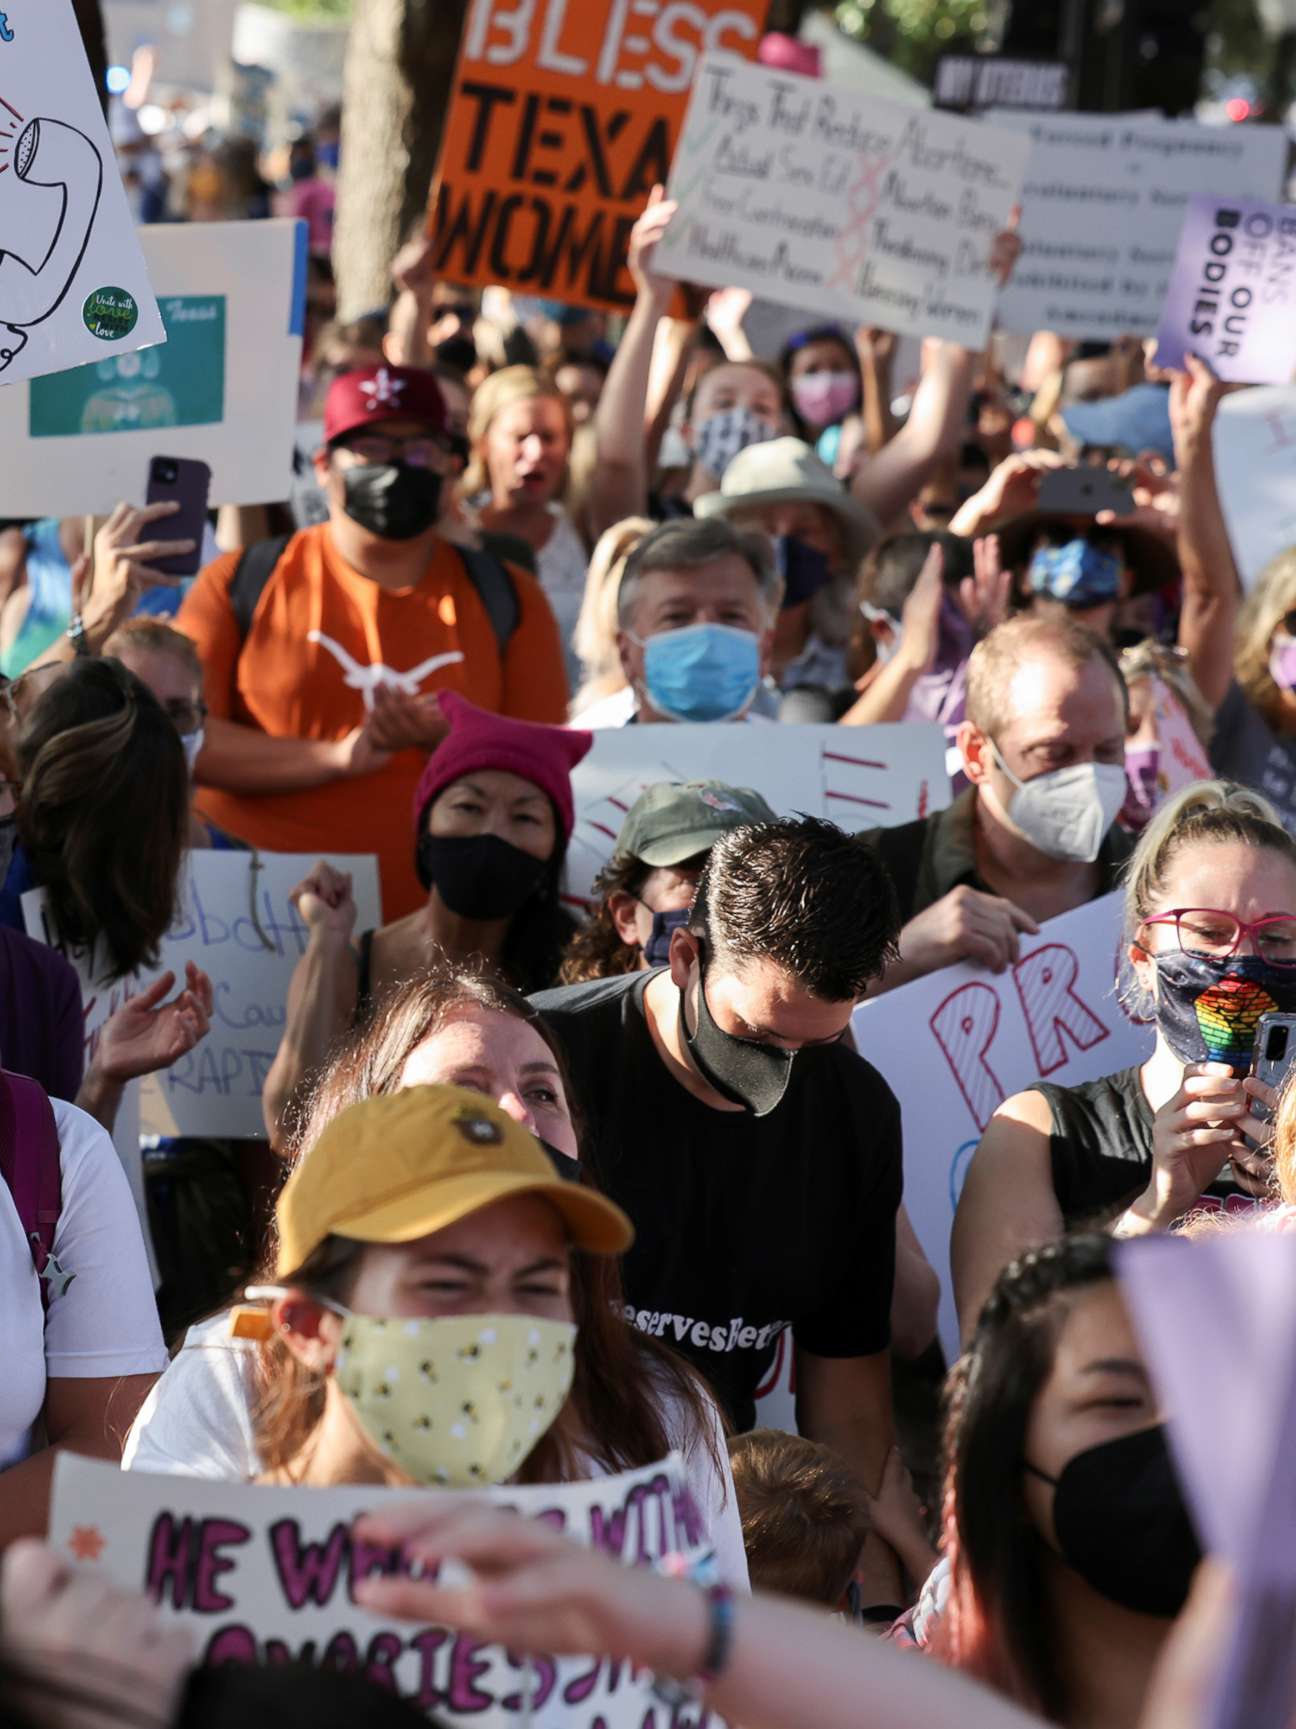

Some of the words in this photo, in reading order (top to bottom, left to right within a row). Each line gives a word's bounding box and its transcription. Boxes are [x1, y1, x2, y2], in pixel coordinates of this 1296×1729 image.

[460, 79, 671, 200] TEXA
[433, 183, 646, 312] WOME
[1189, 207, 1242, 337] BODIES
[1216, 286, 1252, 358] OUR
[930, 943, 1154, 1134] PR
[144, 1511, 251, 1614] HE
